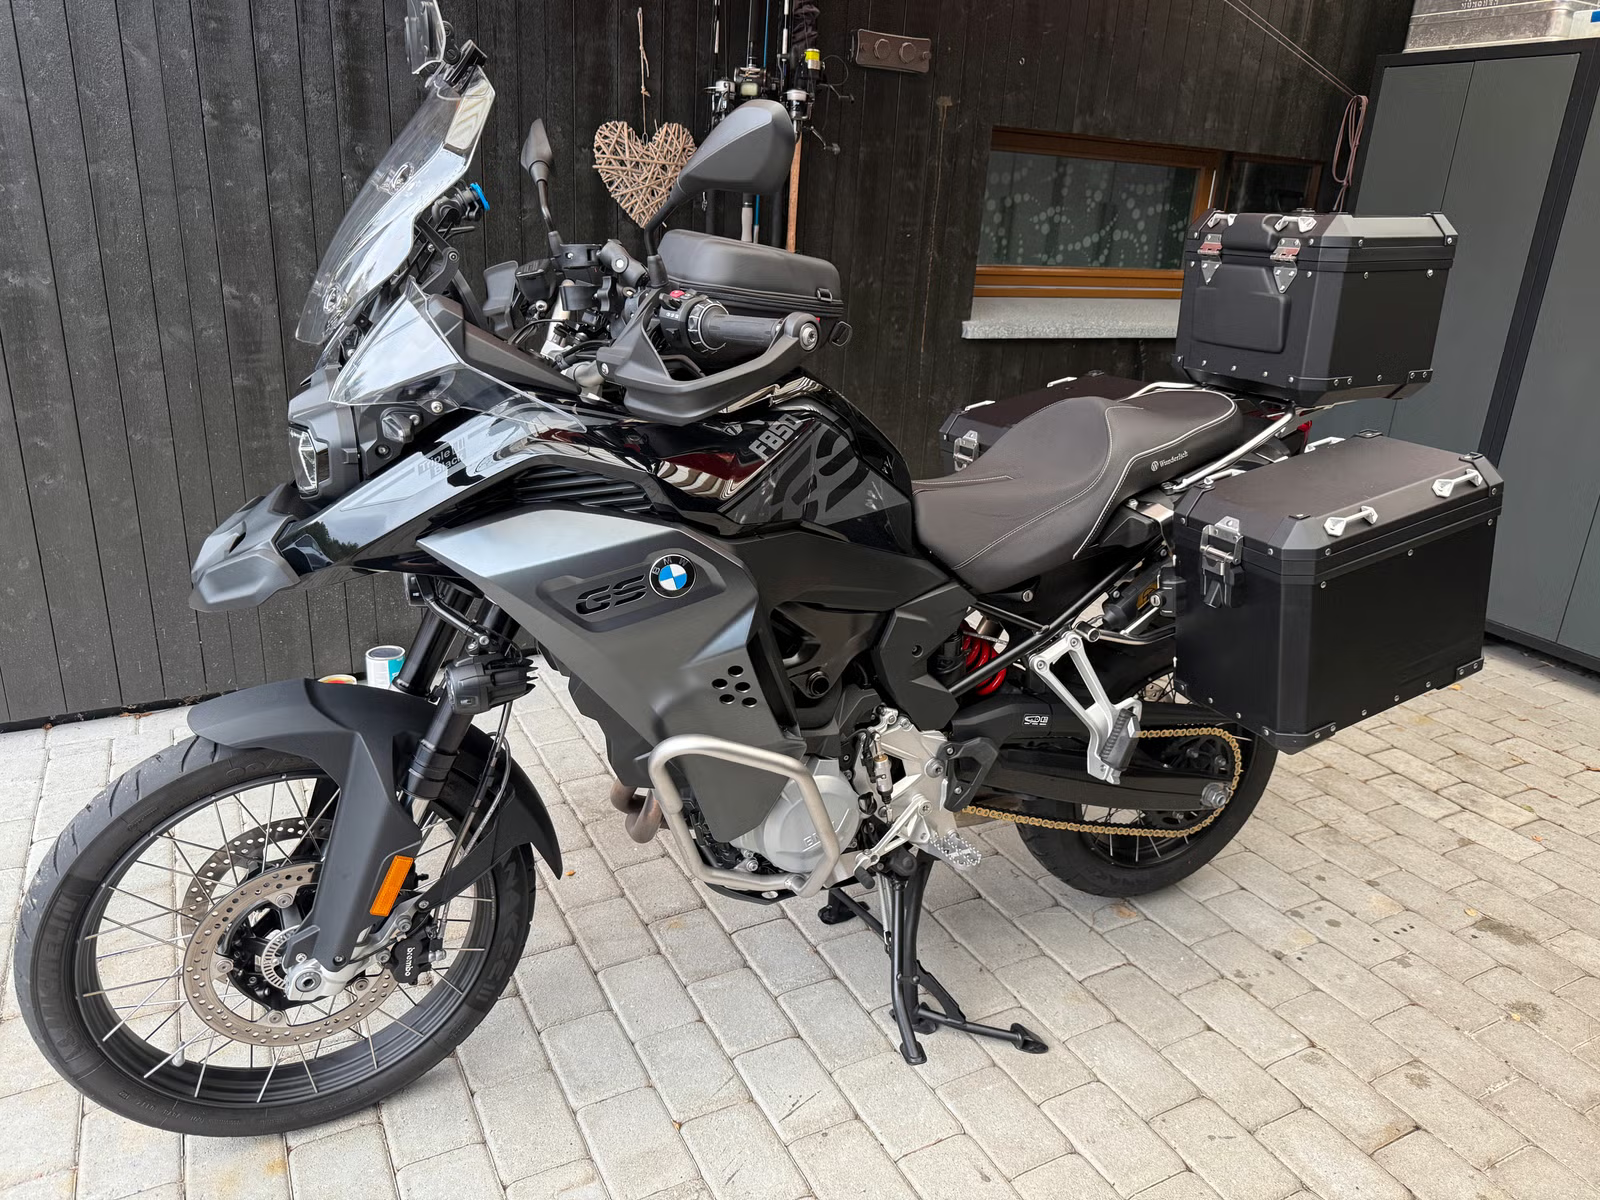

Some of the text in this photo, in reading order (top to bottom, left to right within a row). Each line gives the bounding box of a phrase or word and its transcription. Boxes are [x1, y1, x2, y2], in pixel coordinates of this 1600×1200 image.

[748, 413, 804, 462] F850
[420, 449, 451, 472] Triple
[651, 556, 689, 576] BMW
[575, 574, 648, 615] GS
[404, 946, 416, 977] brembo
